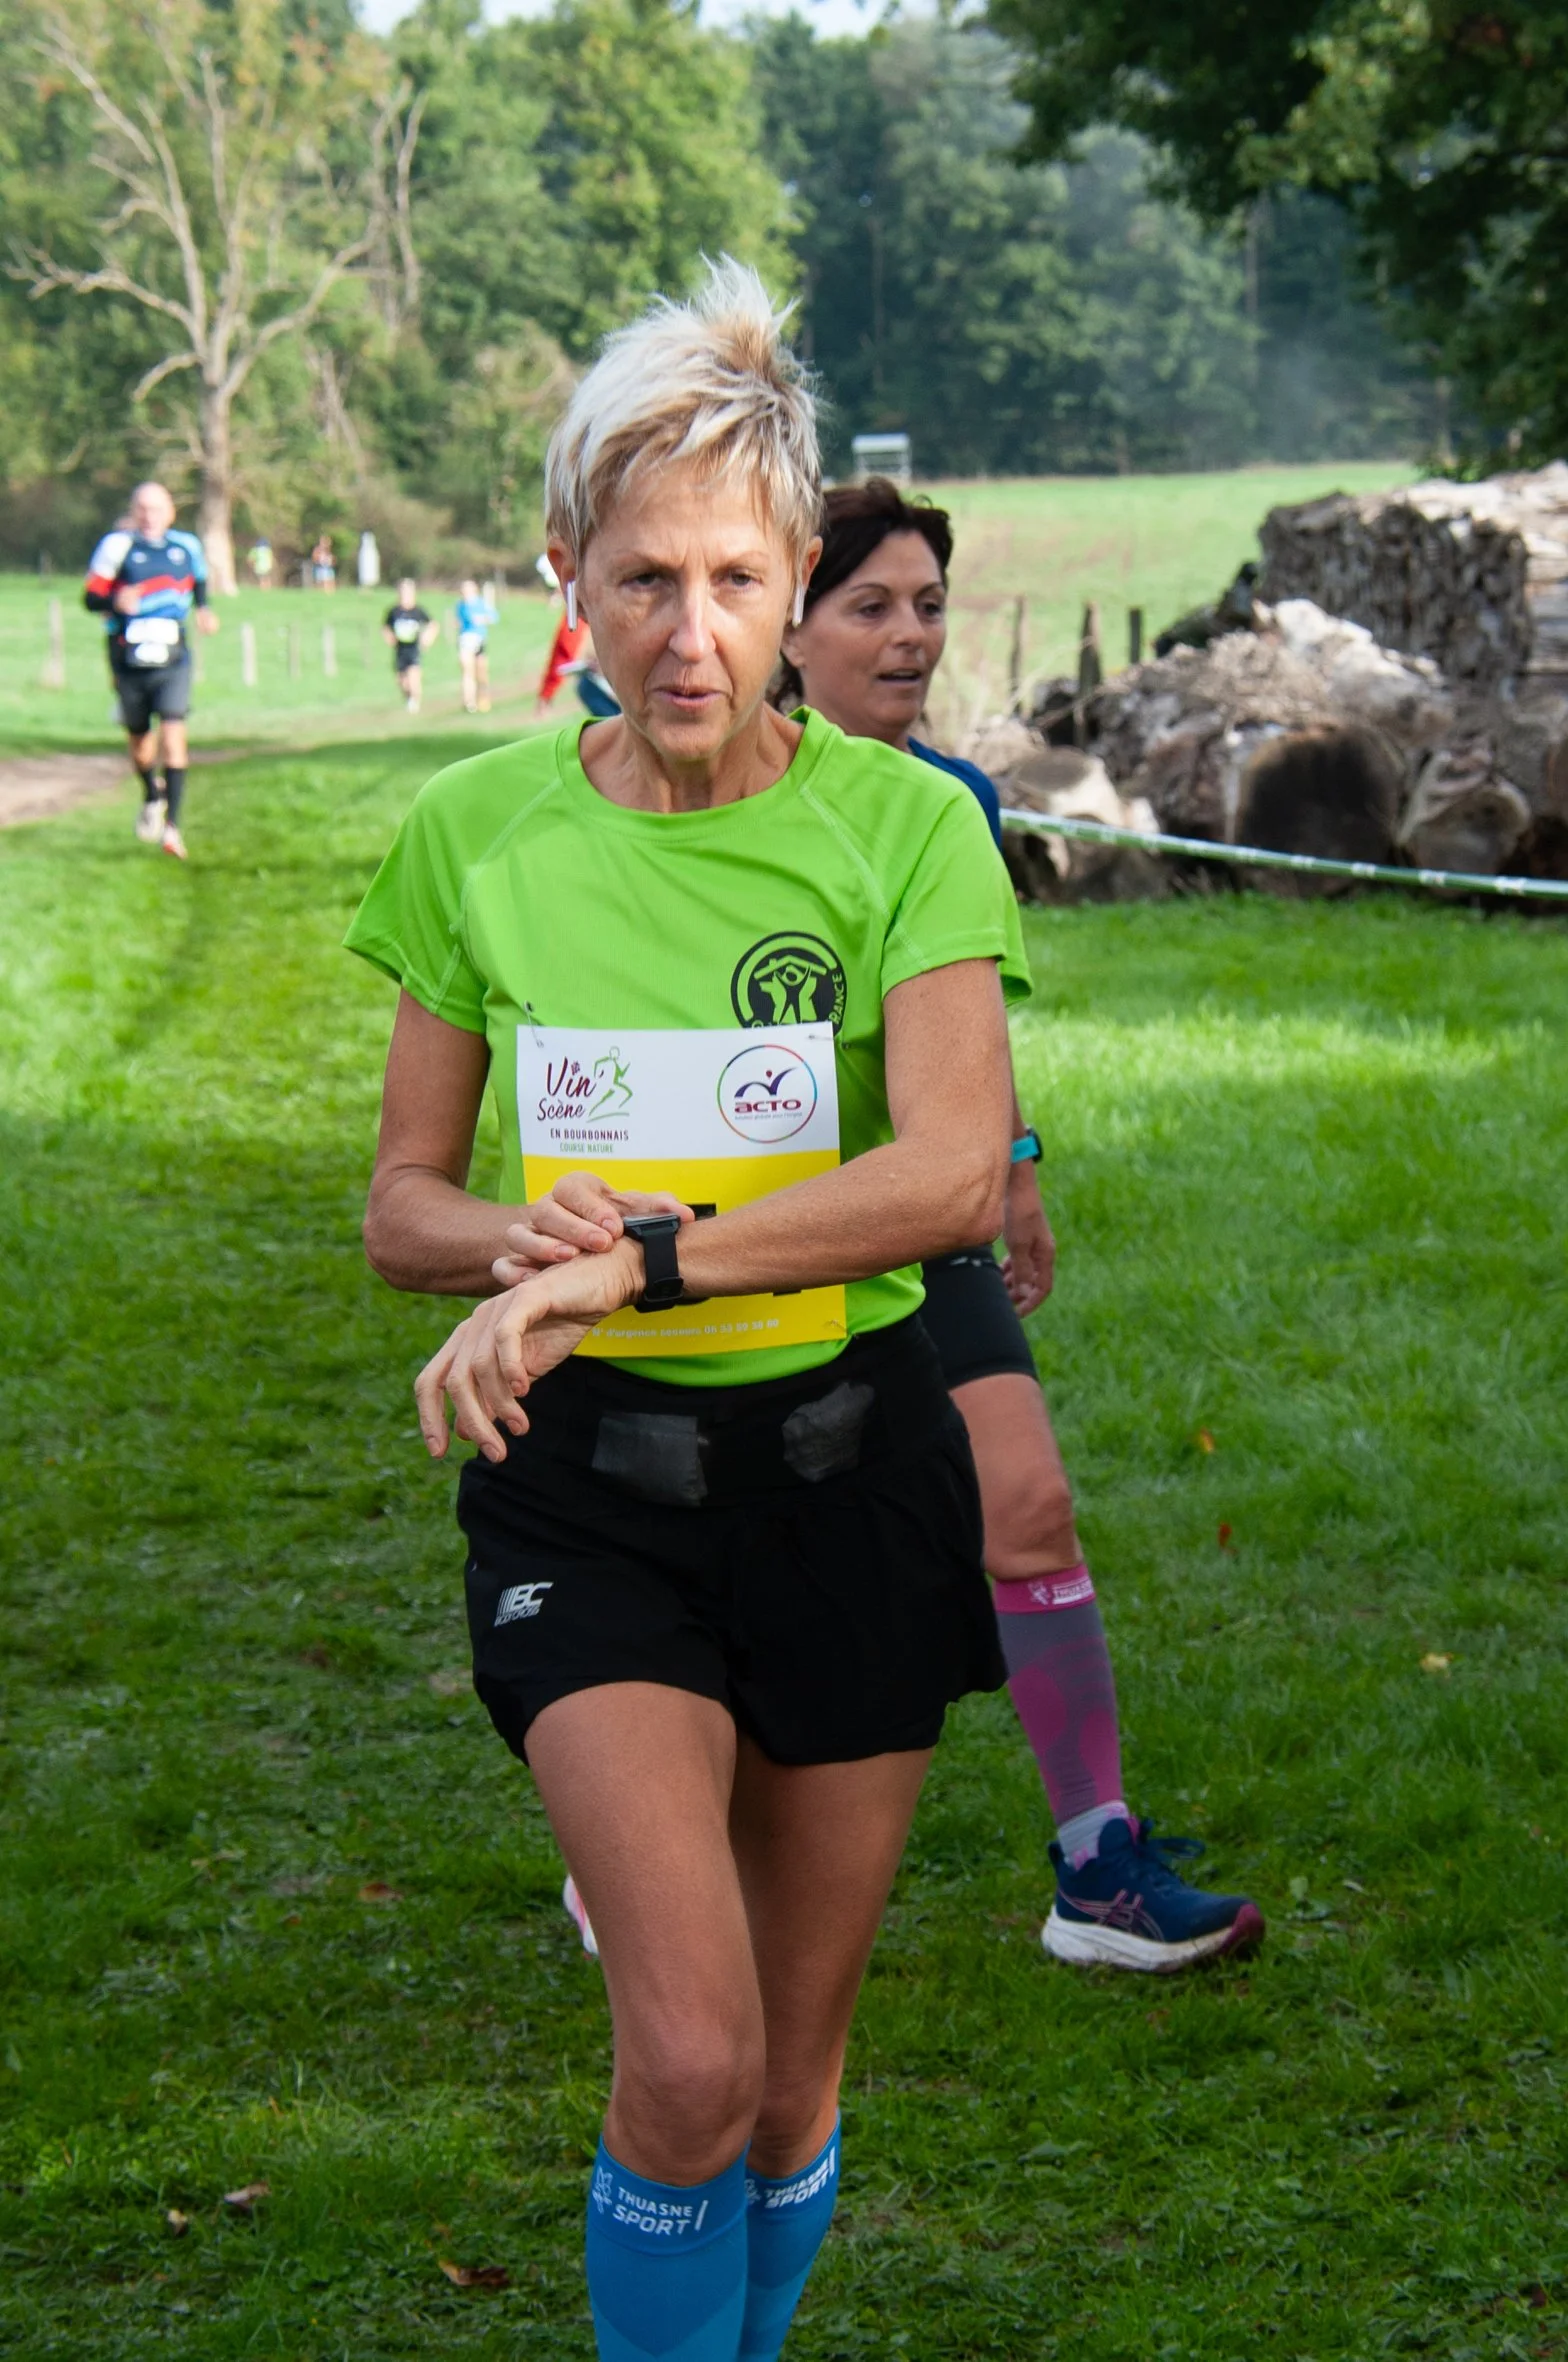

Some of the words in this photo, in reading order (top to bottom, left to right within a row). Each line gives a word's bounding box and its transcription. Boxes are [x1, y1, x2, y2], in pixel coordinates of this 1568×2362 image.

[828, 972, 845, 1025] RANCE
[537, 1097, 586, 1121] Scène
[550, 1127, 561, 1140] EN
[564, 1127, 629, 1141] BOURBONNAIS
[560, 1142, 584, 1153] COURSE
[587, 1143, 614, 1153] NATURE
[616, 2186, 694, 2218] THUASNE
[612, 2203, 691, 2236] SPORT
